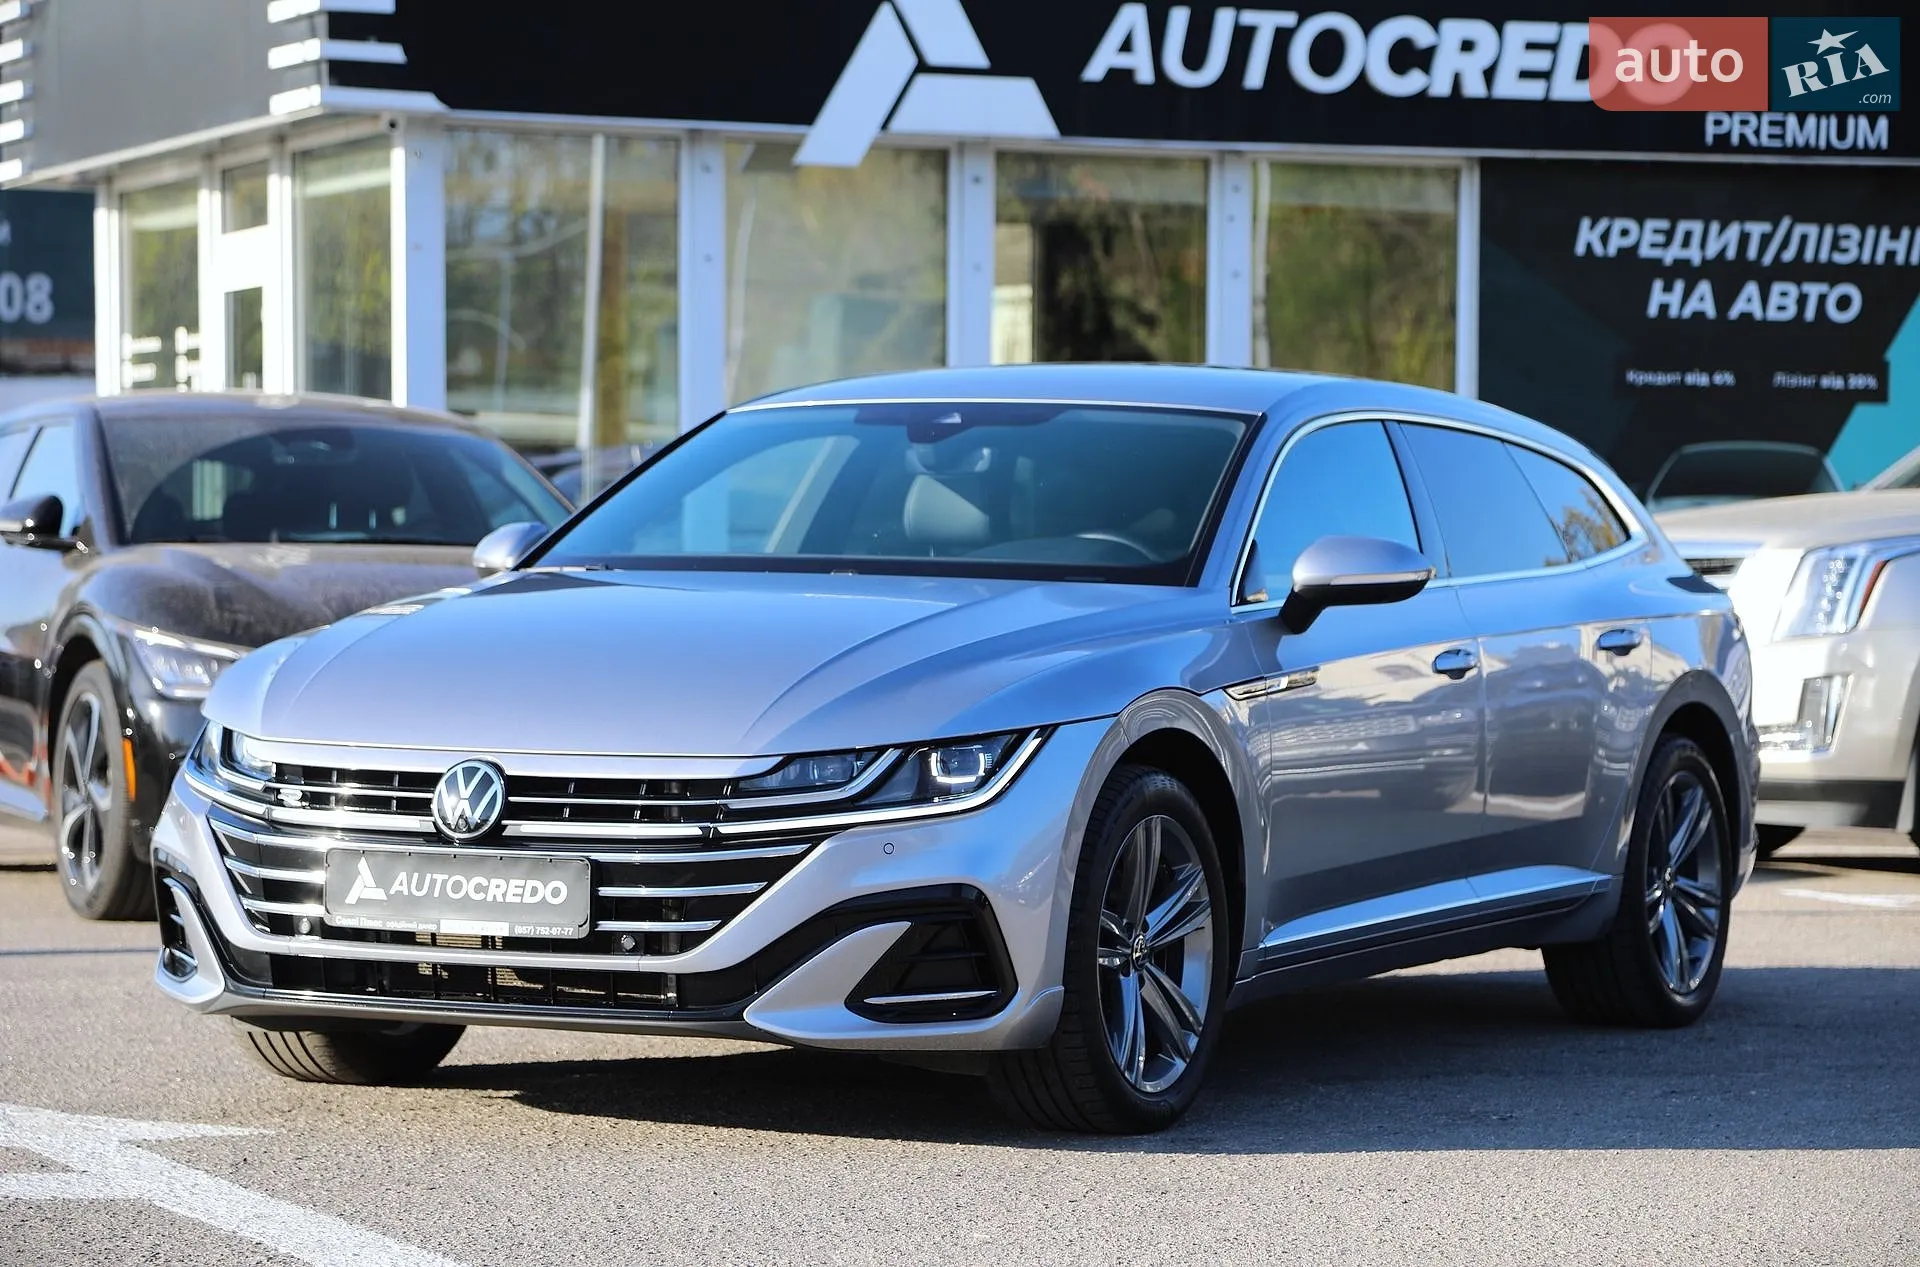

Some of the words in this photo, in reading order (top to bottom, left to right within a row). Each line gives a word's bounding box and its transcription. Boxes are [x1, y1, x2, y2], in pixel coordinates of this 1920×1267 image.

[1080, 2, 1695, 105] AUTOCREDO
[1704, 111, 1889, 150] PREMIUM
[1646, 278, 1718, 320] НА
[1727, 280, 1863, 324] АВТО
[389, 871, 568, 905] AUTOCREDO
